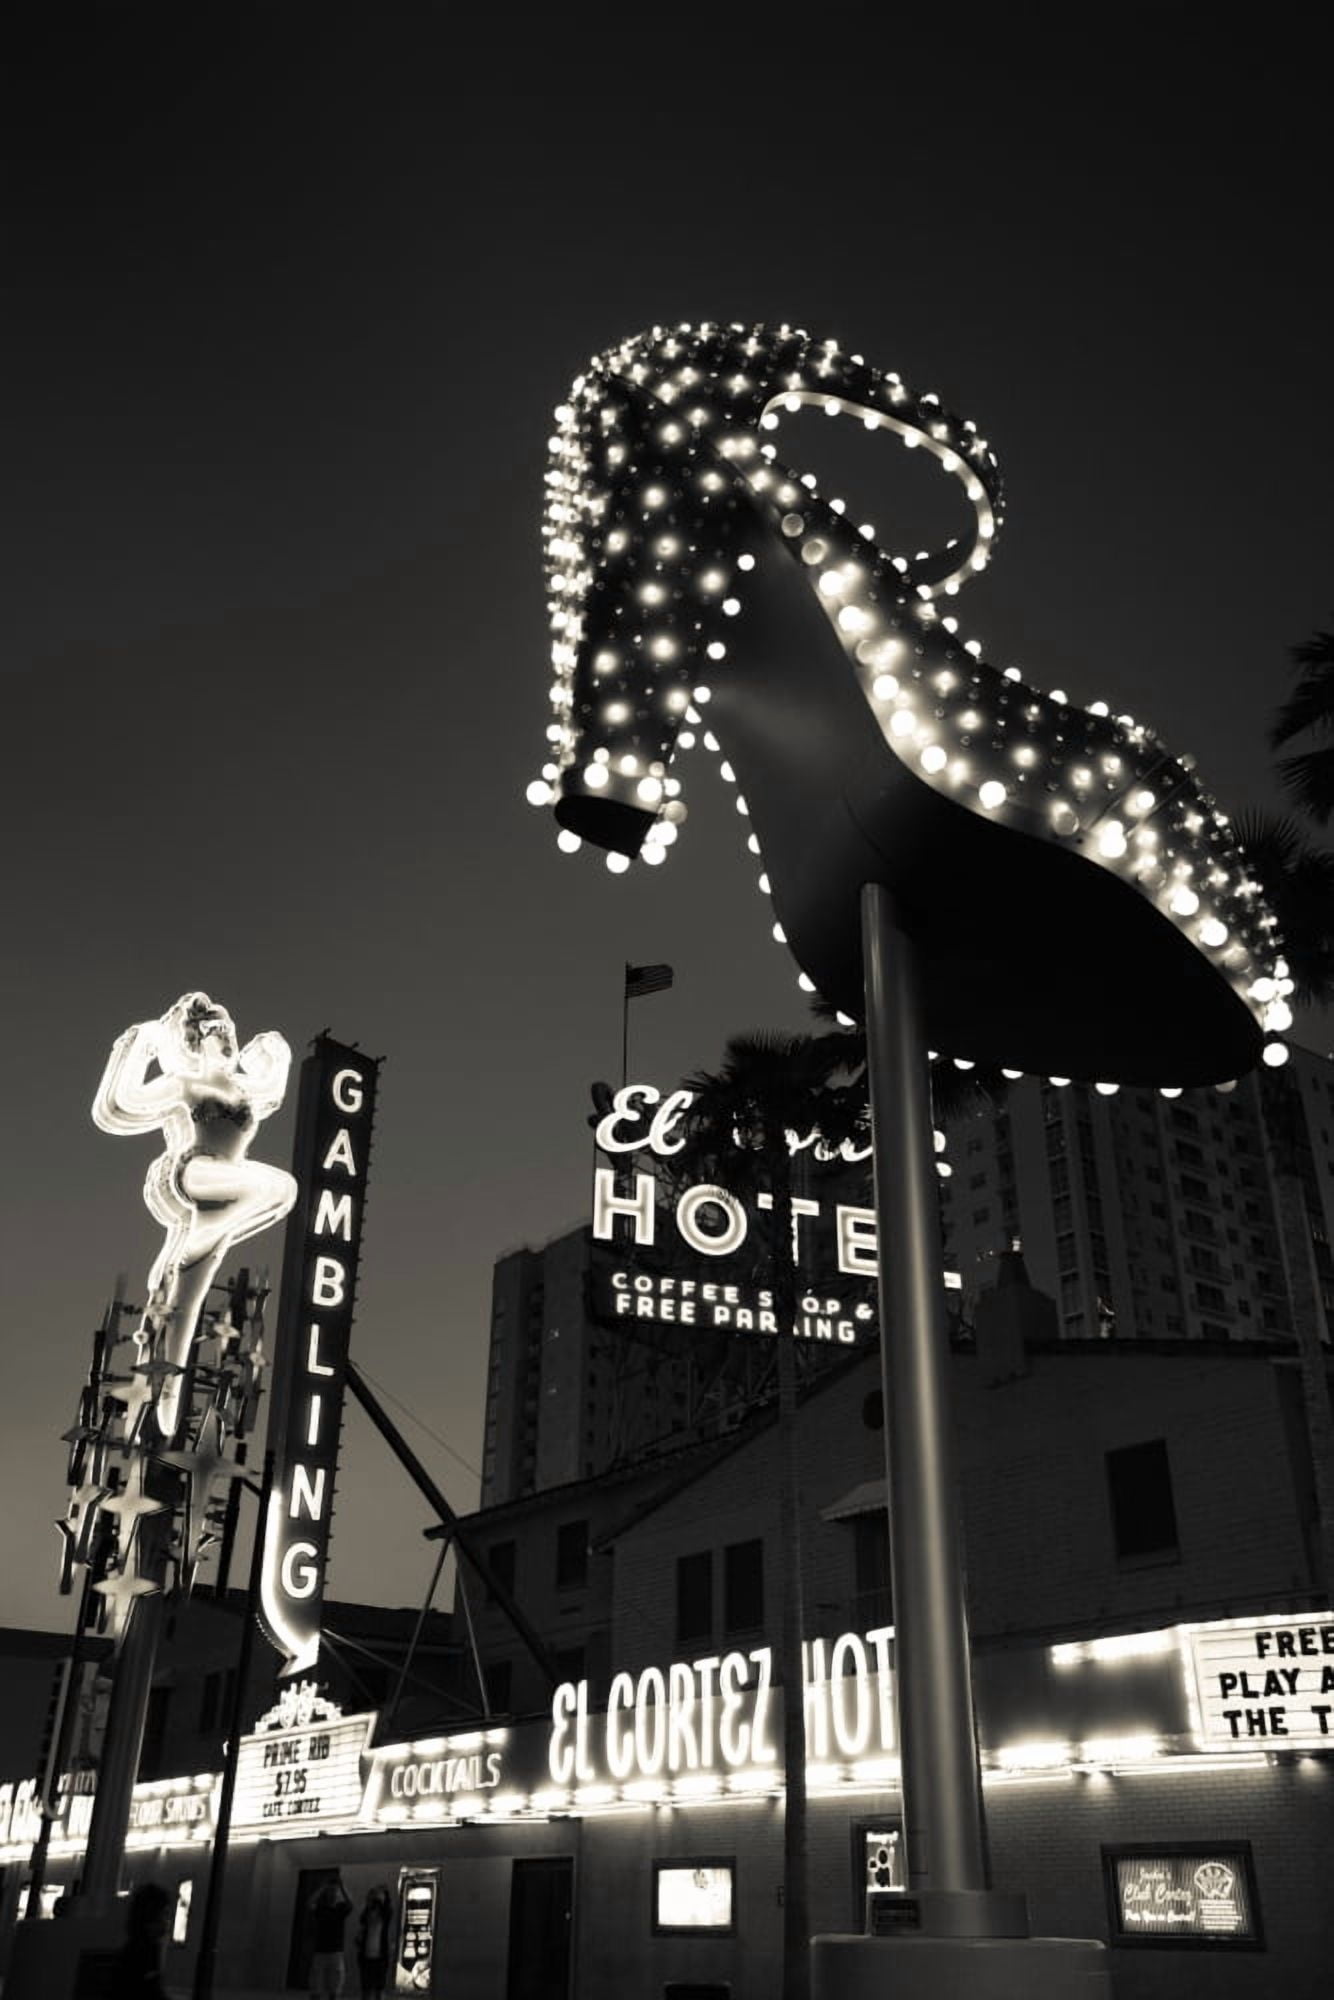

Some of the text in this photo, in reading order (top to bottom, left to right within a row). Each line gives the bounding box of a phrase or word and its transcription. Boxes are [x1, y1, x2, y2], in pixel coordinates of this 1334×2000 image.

[595, 1084, 694, 1155] El
[592, 1167, 962, 1290] HOTE
[612, 1272, 874, 1321] COFFEE SOP &
[616, 1293, 857, 1343] FREE PARING
[280, 1068, 364, 1599] GAMBLING
[1255, 1626, 1334, 1659] FREE
[1218, 1667, 1301, 1699] PLAY
[549, 1679, 596, 1783] EL
[606, 1646, 777, 1778] CORTEZ
[1222, 1706, 1289, 1738] THE
[263, 1734, 331, 1768] PRIME RIB
[390, 1752, 502, 1797] COCKTAILS
